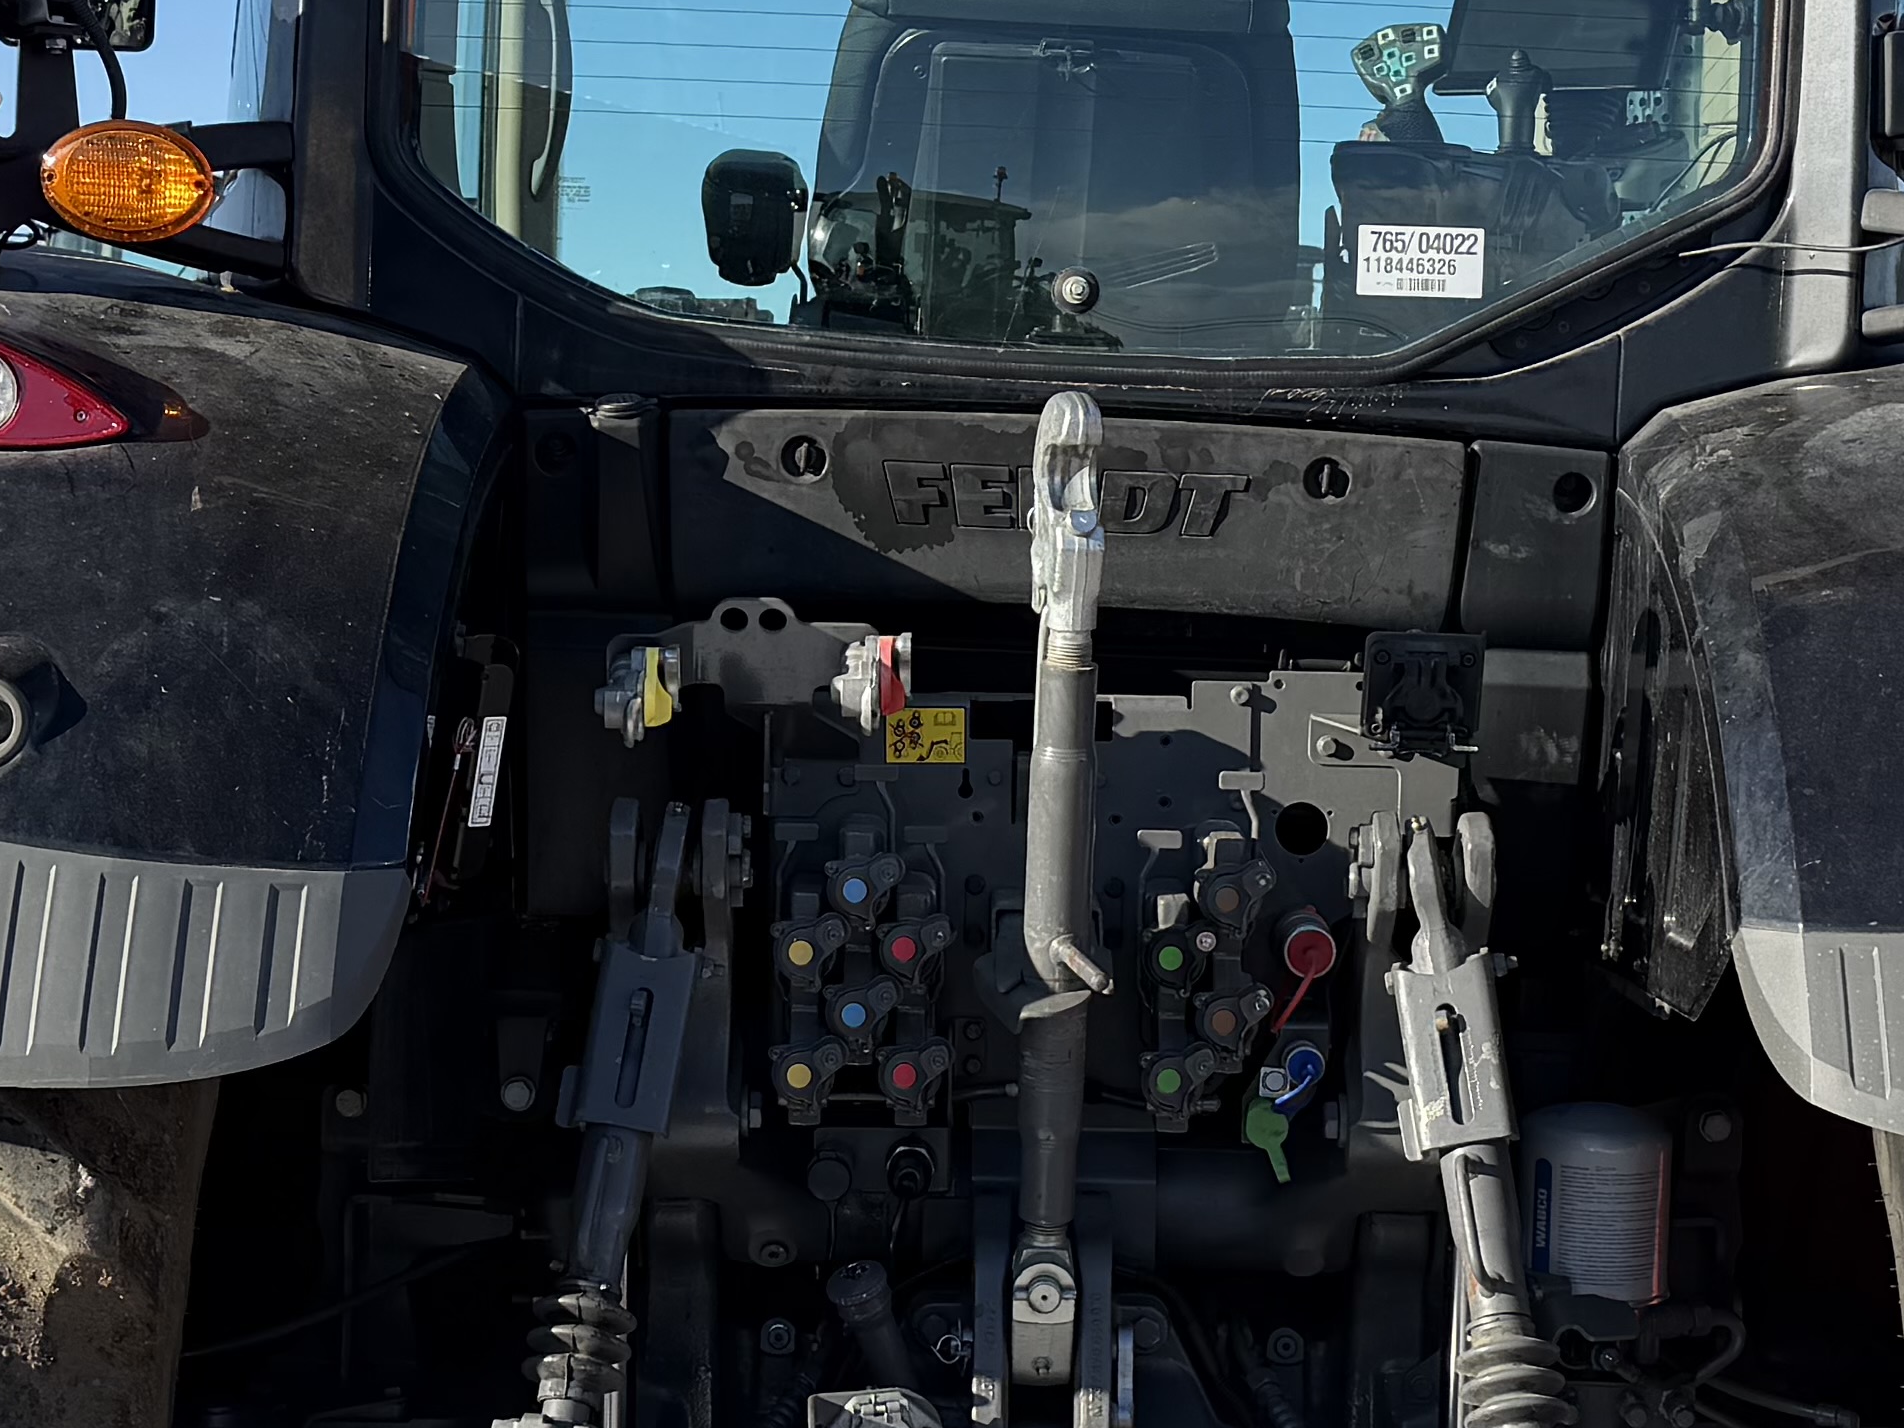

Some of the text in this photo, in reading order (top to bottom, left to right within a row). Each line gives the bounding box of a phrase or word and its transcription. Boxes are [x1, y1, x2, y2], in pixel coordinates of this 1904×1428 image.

[1362, 255, 1457, 276] 118446326
[883, 459, 1252, 539] FEDT
[1535, 1187, 1548, 1248] WABCO
